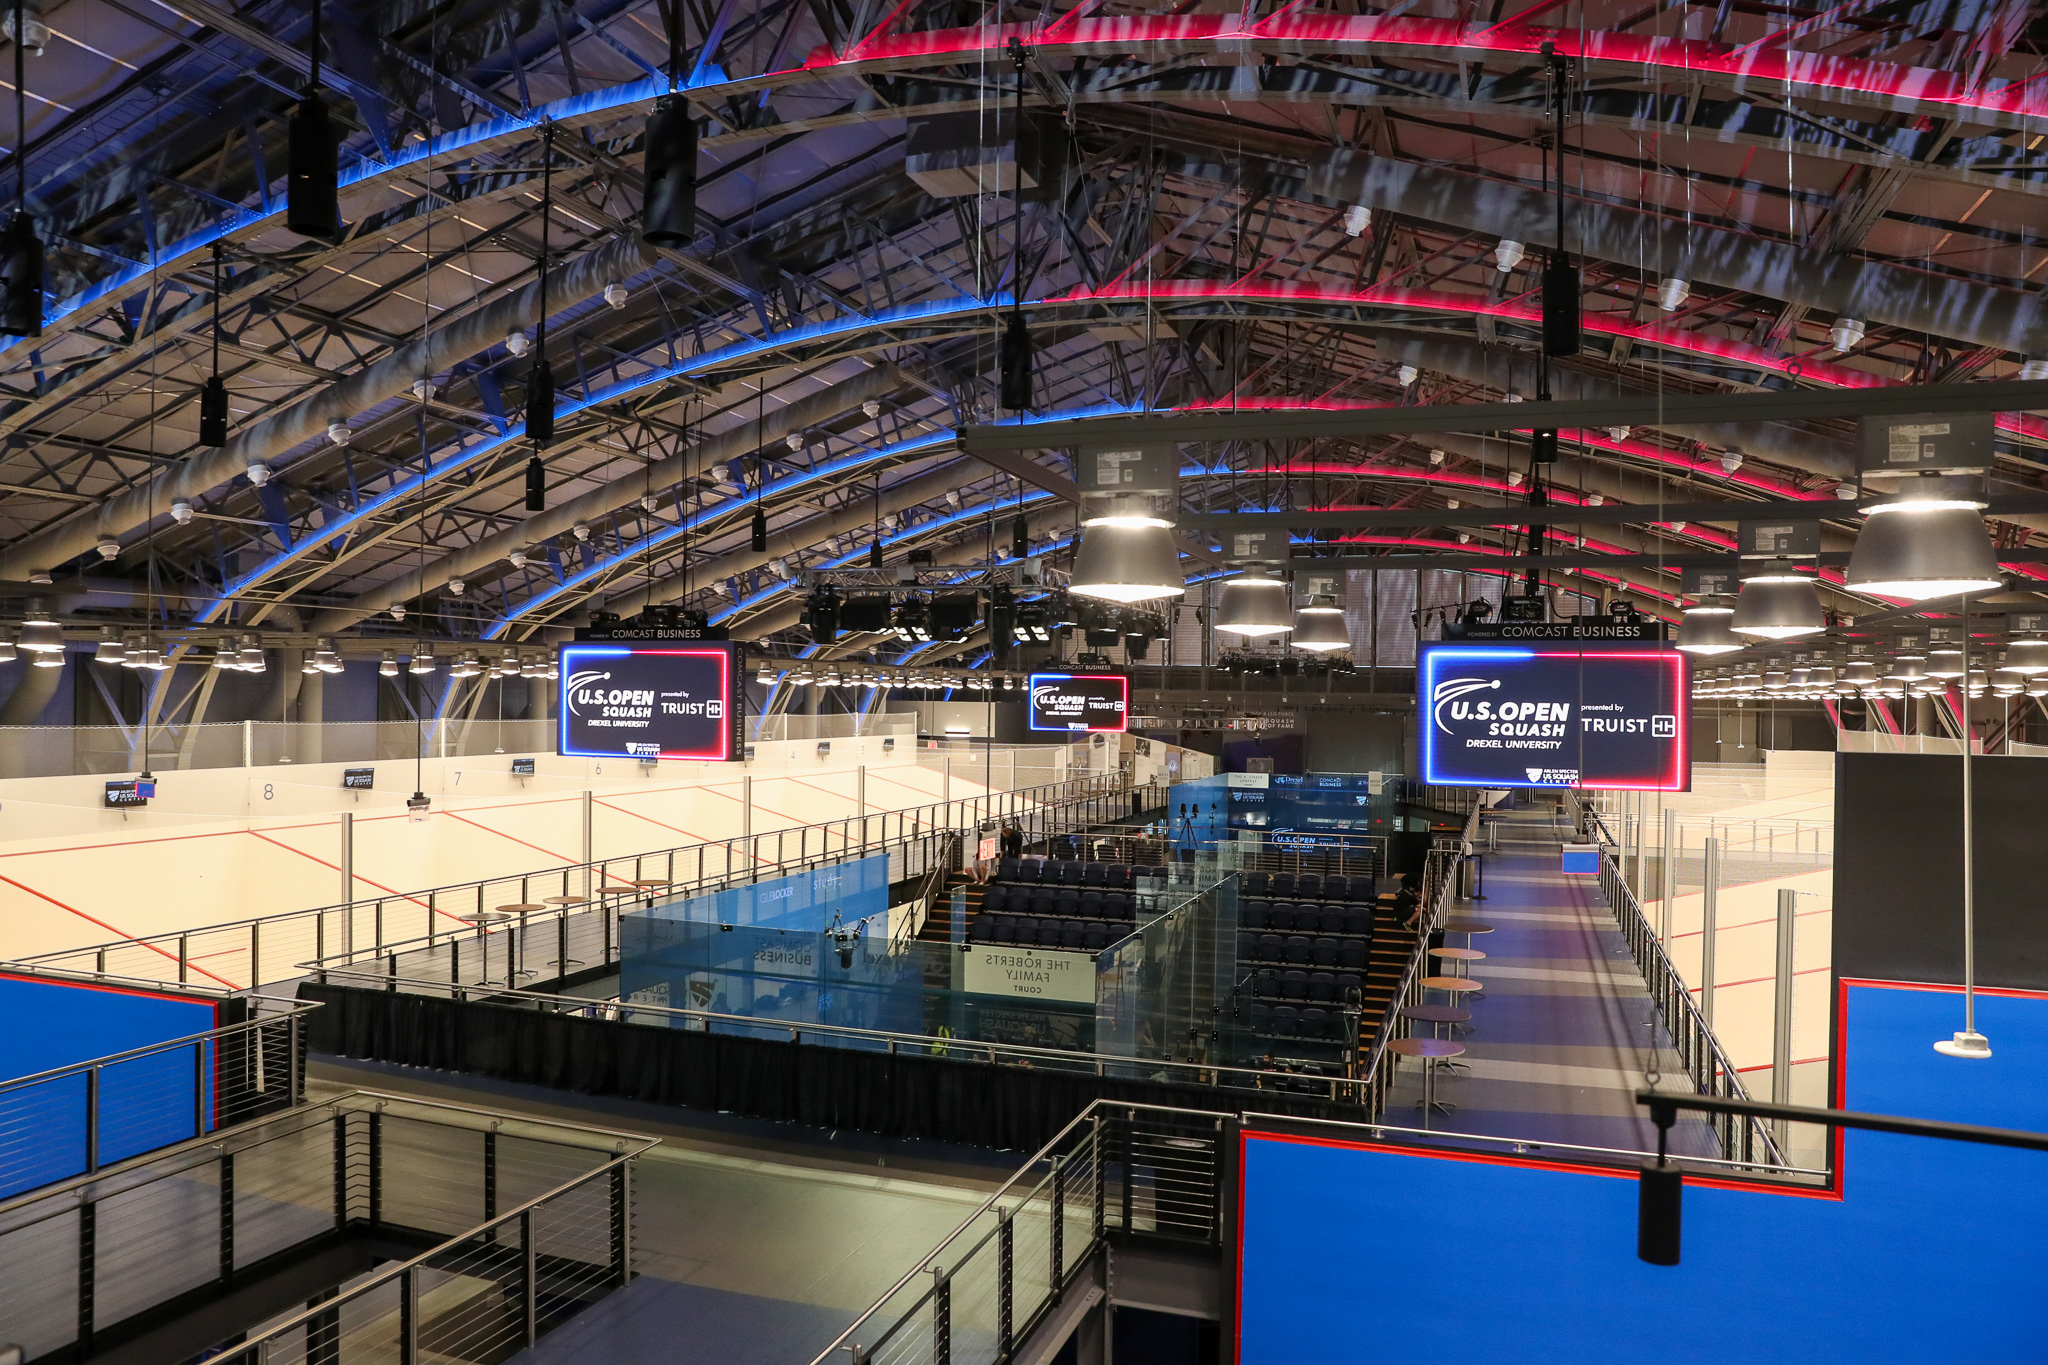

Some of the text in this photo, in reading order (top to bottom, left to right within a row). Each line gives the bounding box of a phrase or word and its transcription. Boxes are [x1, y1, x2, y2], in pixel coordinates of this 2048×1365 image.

[612, 629, 654, 639] COMCAST
[657, 629, 701, 638] BUSINESS
[1502, 626, 1568, 638] COMCAST
[1573, 626, 1641, 637] BUSINESS
[602, 706, 652, 718] SQUASH
[661, 702, 705, 715] TRUIST
[1088, 702, 1114, 710] TRUIST
[1581, 704, 1624, 712] presented by
[588, 719, 650, 728] DREXEL UNIVERSITY
[1489, 722, 1566, 737] SQUASH
[1581, 718, 1648, 733] TRUIST
[1466, 739, 1562, 749] DREXEL UNIVERSITY
[595, 763, 602, 775] 6
[454, 771, 462, 786] 7
[264, 784, 274, 800] 8
